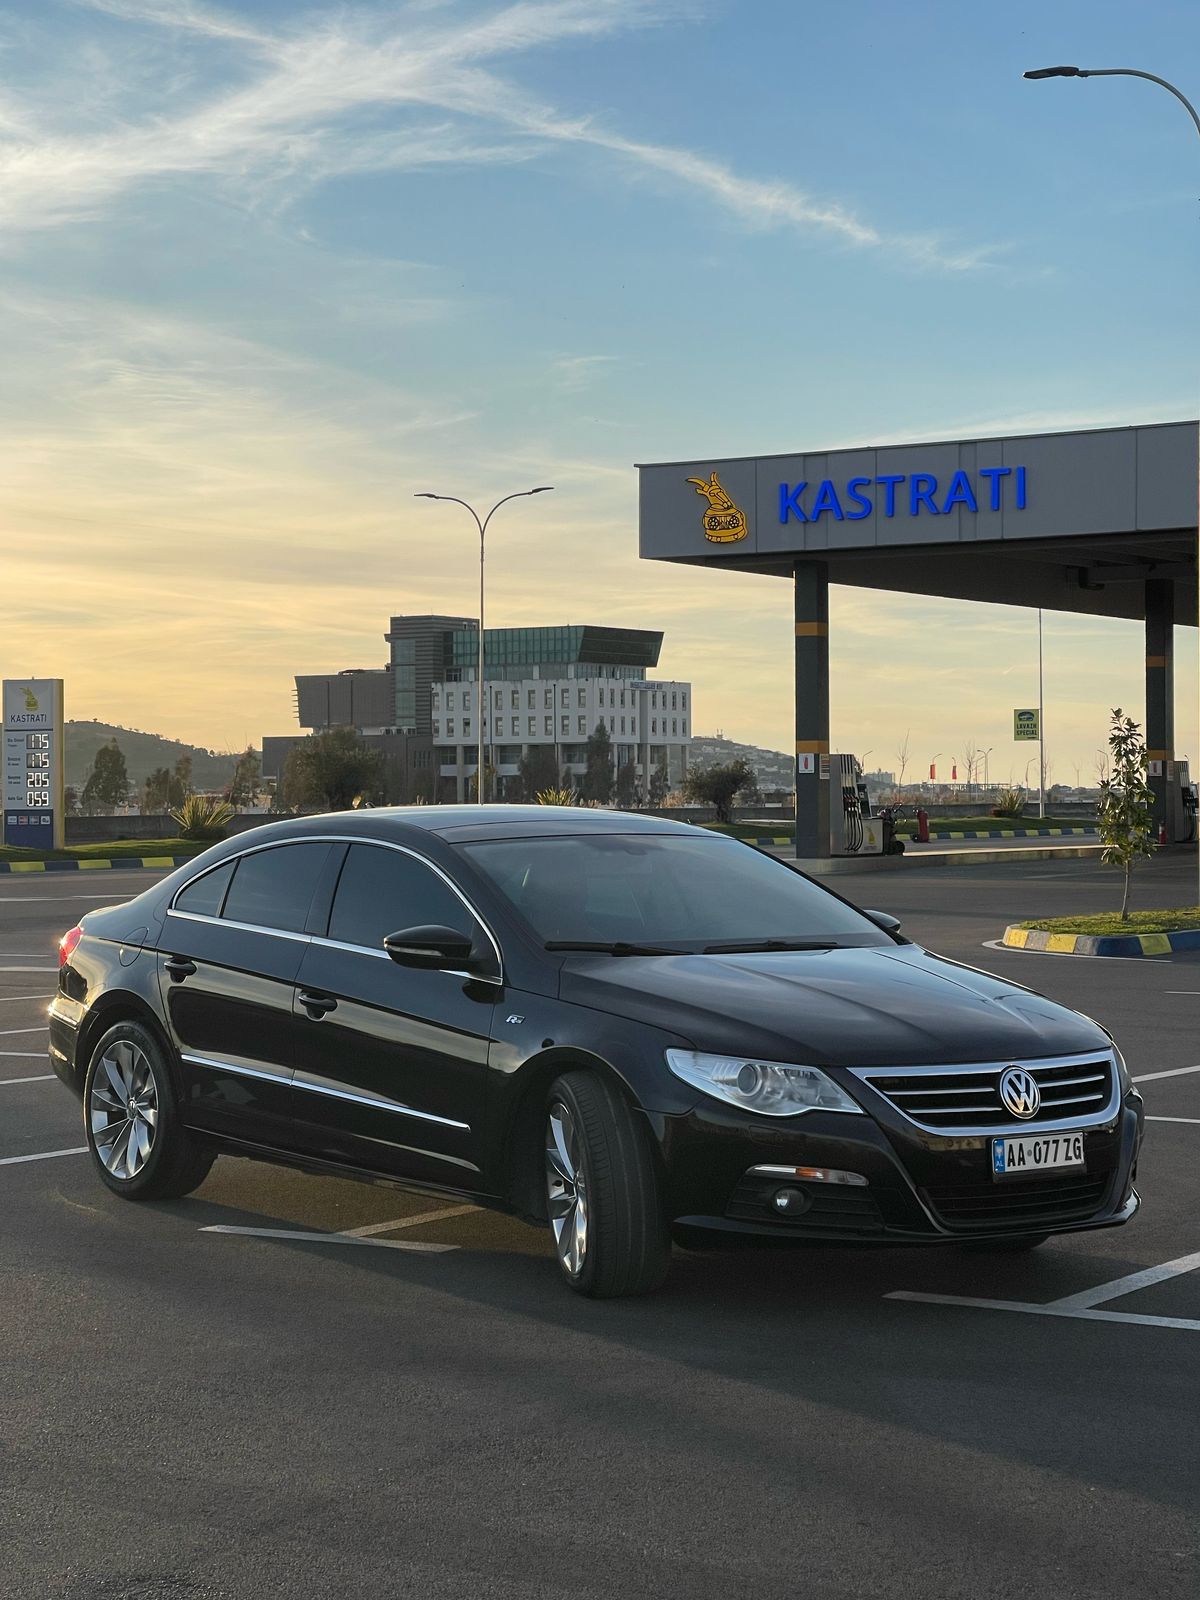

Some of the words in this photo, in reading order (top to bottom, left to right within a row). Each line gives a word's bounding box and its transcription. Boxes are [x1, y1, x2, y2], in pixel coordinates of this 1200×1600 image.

[779, 466, 1026, 524] KASTRATI
[10, 713, 47, 723] KASTRATI
[31, 734, 49, 749] 175
[31, 753, 49, 768] 175
[27, 772, 49, 788] 205
[27, 791, 49, 807] 059
[1007, 1143, 1026, 1167] AA
[1033, 1140, 1060, 1165] 077
[1063, 1137, 1082, 1160] ZG
